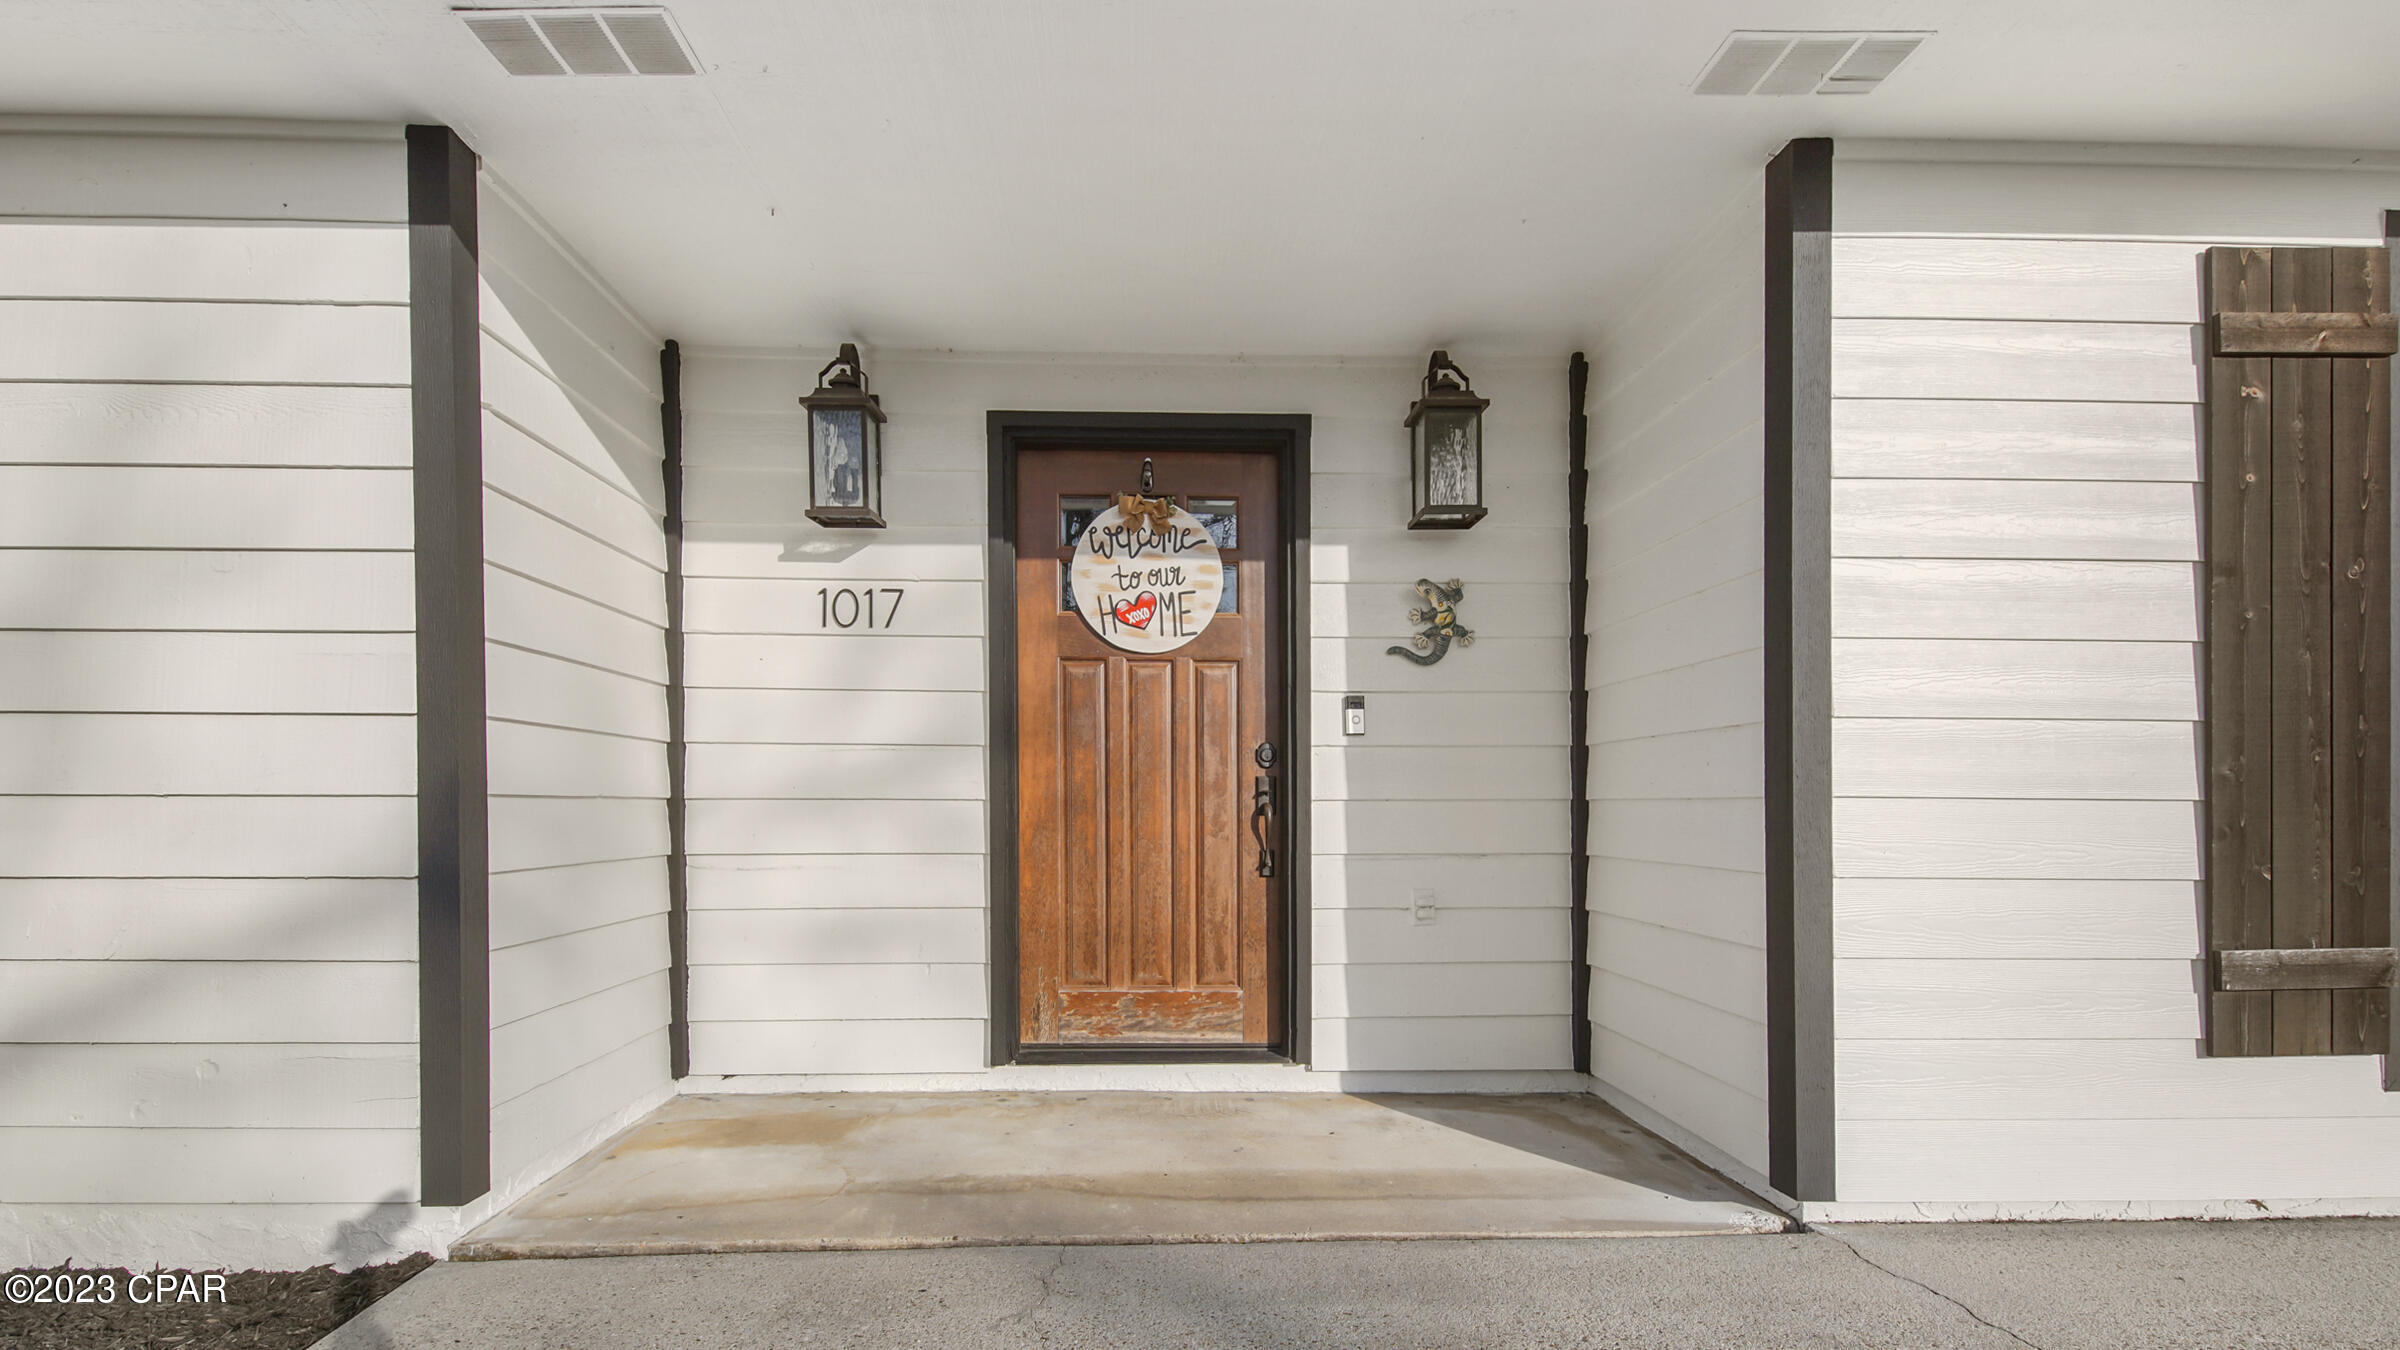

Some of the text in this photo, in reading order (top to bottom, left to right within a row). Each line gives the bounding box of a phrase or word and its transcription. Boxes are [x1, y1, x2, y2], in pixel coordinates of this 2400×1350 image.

[1111, 564, 1186, 591] to our
[817, 587, 904, 629] 1017
